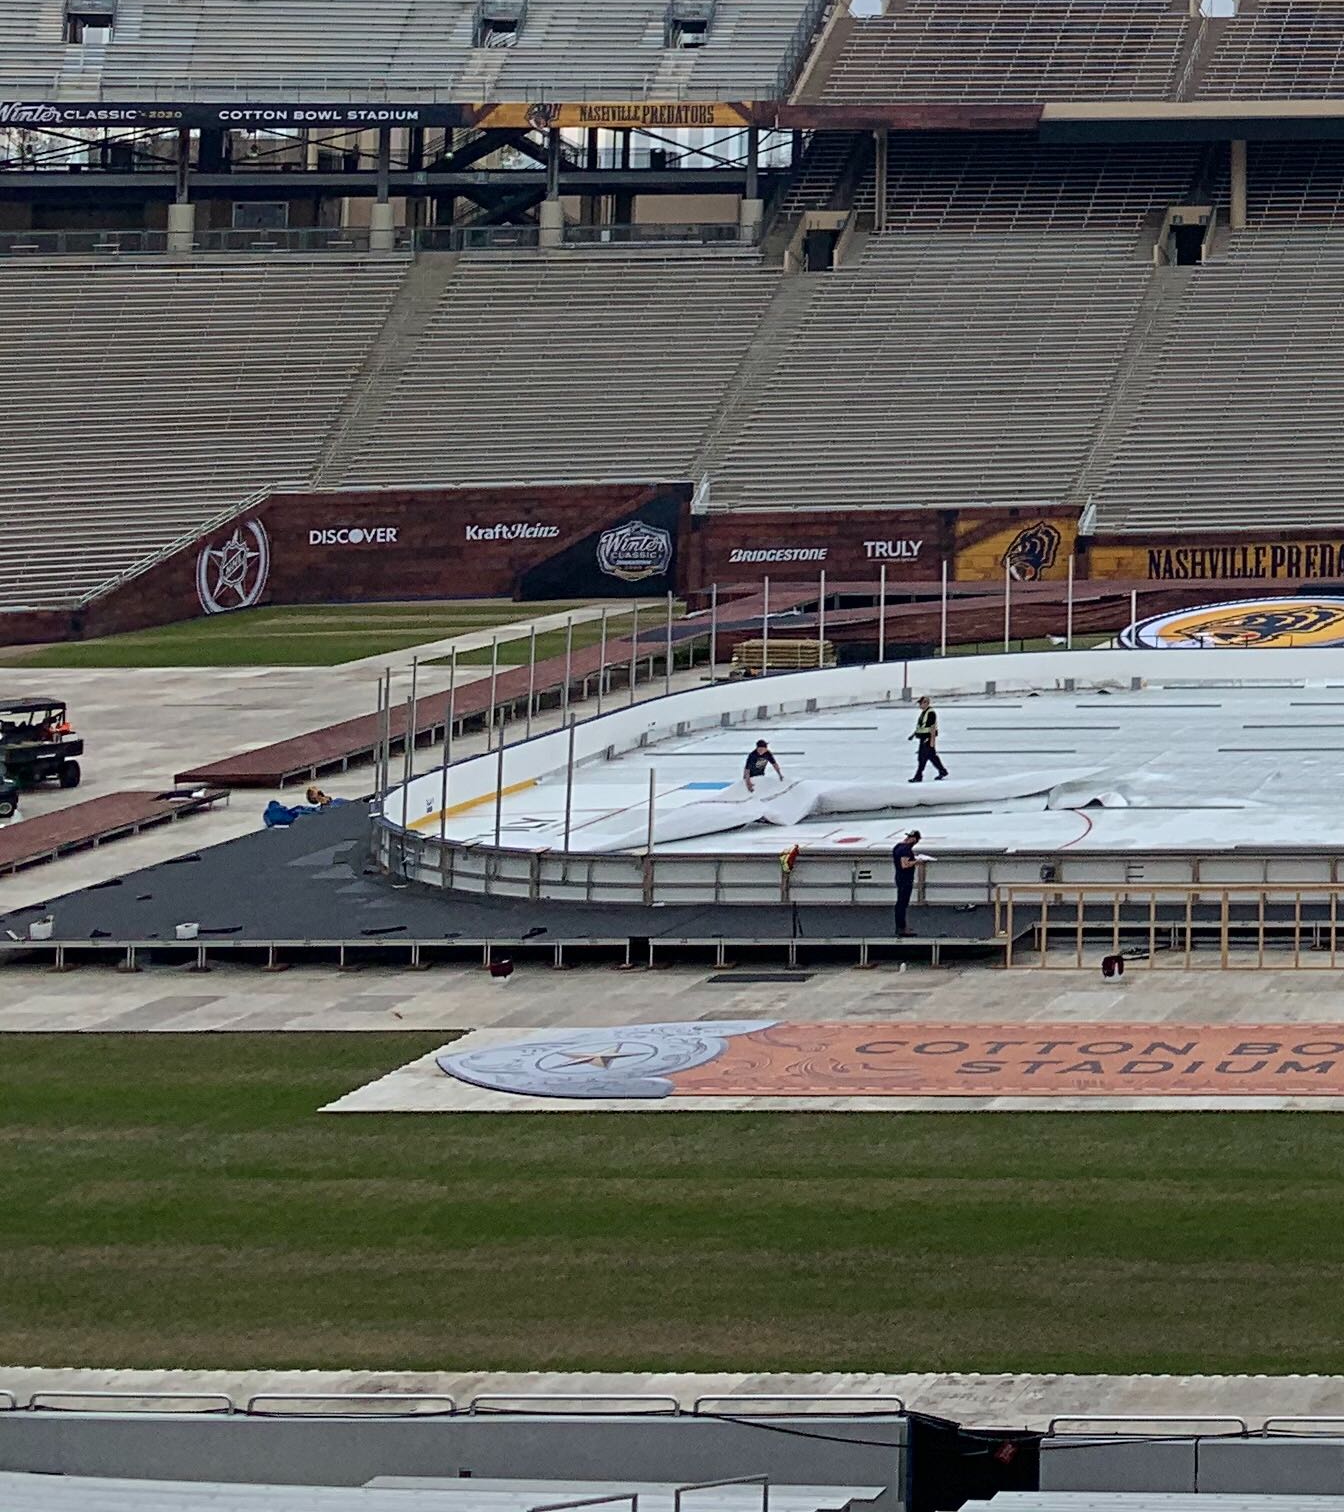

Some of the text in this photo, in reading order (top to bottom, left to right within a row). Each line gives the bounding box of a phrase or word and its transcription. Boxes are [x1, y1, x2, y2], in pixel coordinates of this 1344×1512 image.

[63, 110, 137, 119] CLASSIC
[218, 110, 419, 120] COTTON BOWL STADIUM
[579, 105, 714, 125] NASHVILLE PREDATORS
[309, 527, 398, 545] DISCOVER
[601, 531, 665, 557] Winter
[611, 551, 658, 559] CLASSIC
[728, 547, 829, 563] BRIDGESTONE
[863, 540, 923, 558] TRULY
[1147, 547, 1267, 580] NASHVILLE
[853, 1040, 1202, 1056] COTTON
[953, 1060, 1336, 1075] STADIUM
